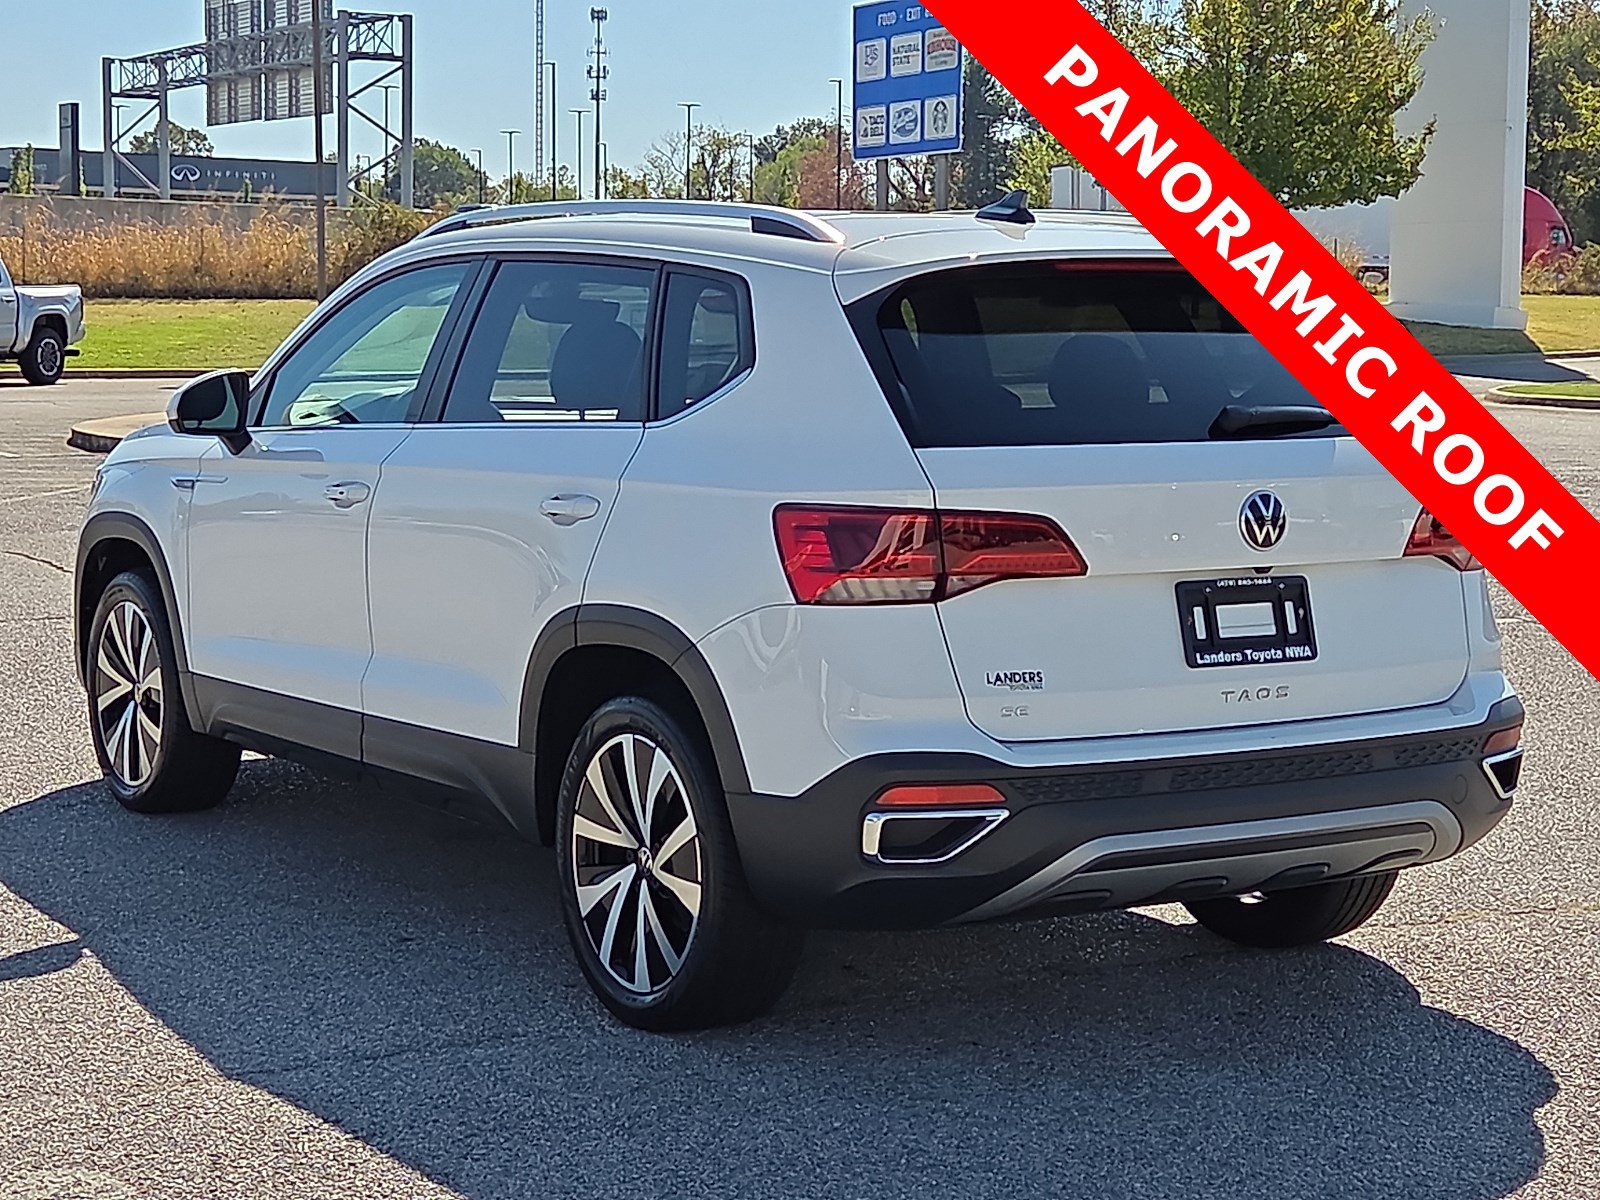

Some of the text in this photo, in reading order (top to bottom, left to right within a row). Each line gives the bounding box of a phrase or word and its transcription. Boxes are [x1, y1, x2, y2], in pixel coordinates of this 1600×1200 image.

[892, 43, 921, 55] NATURAL
[892, 55, 911, 66] STATE
[869, 114, 884, 125] TACO
[869, 126, 884, 137] BELL
[206, 169, 275, 180] INFINITI
[1196, 645, 1312, 665] Landers Toyota NWA
[986, 671, 1043, 686] LANDERS
[1221, 685, 1290, 703] TAOS
[1001, 705, 1029, 717] SE
